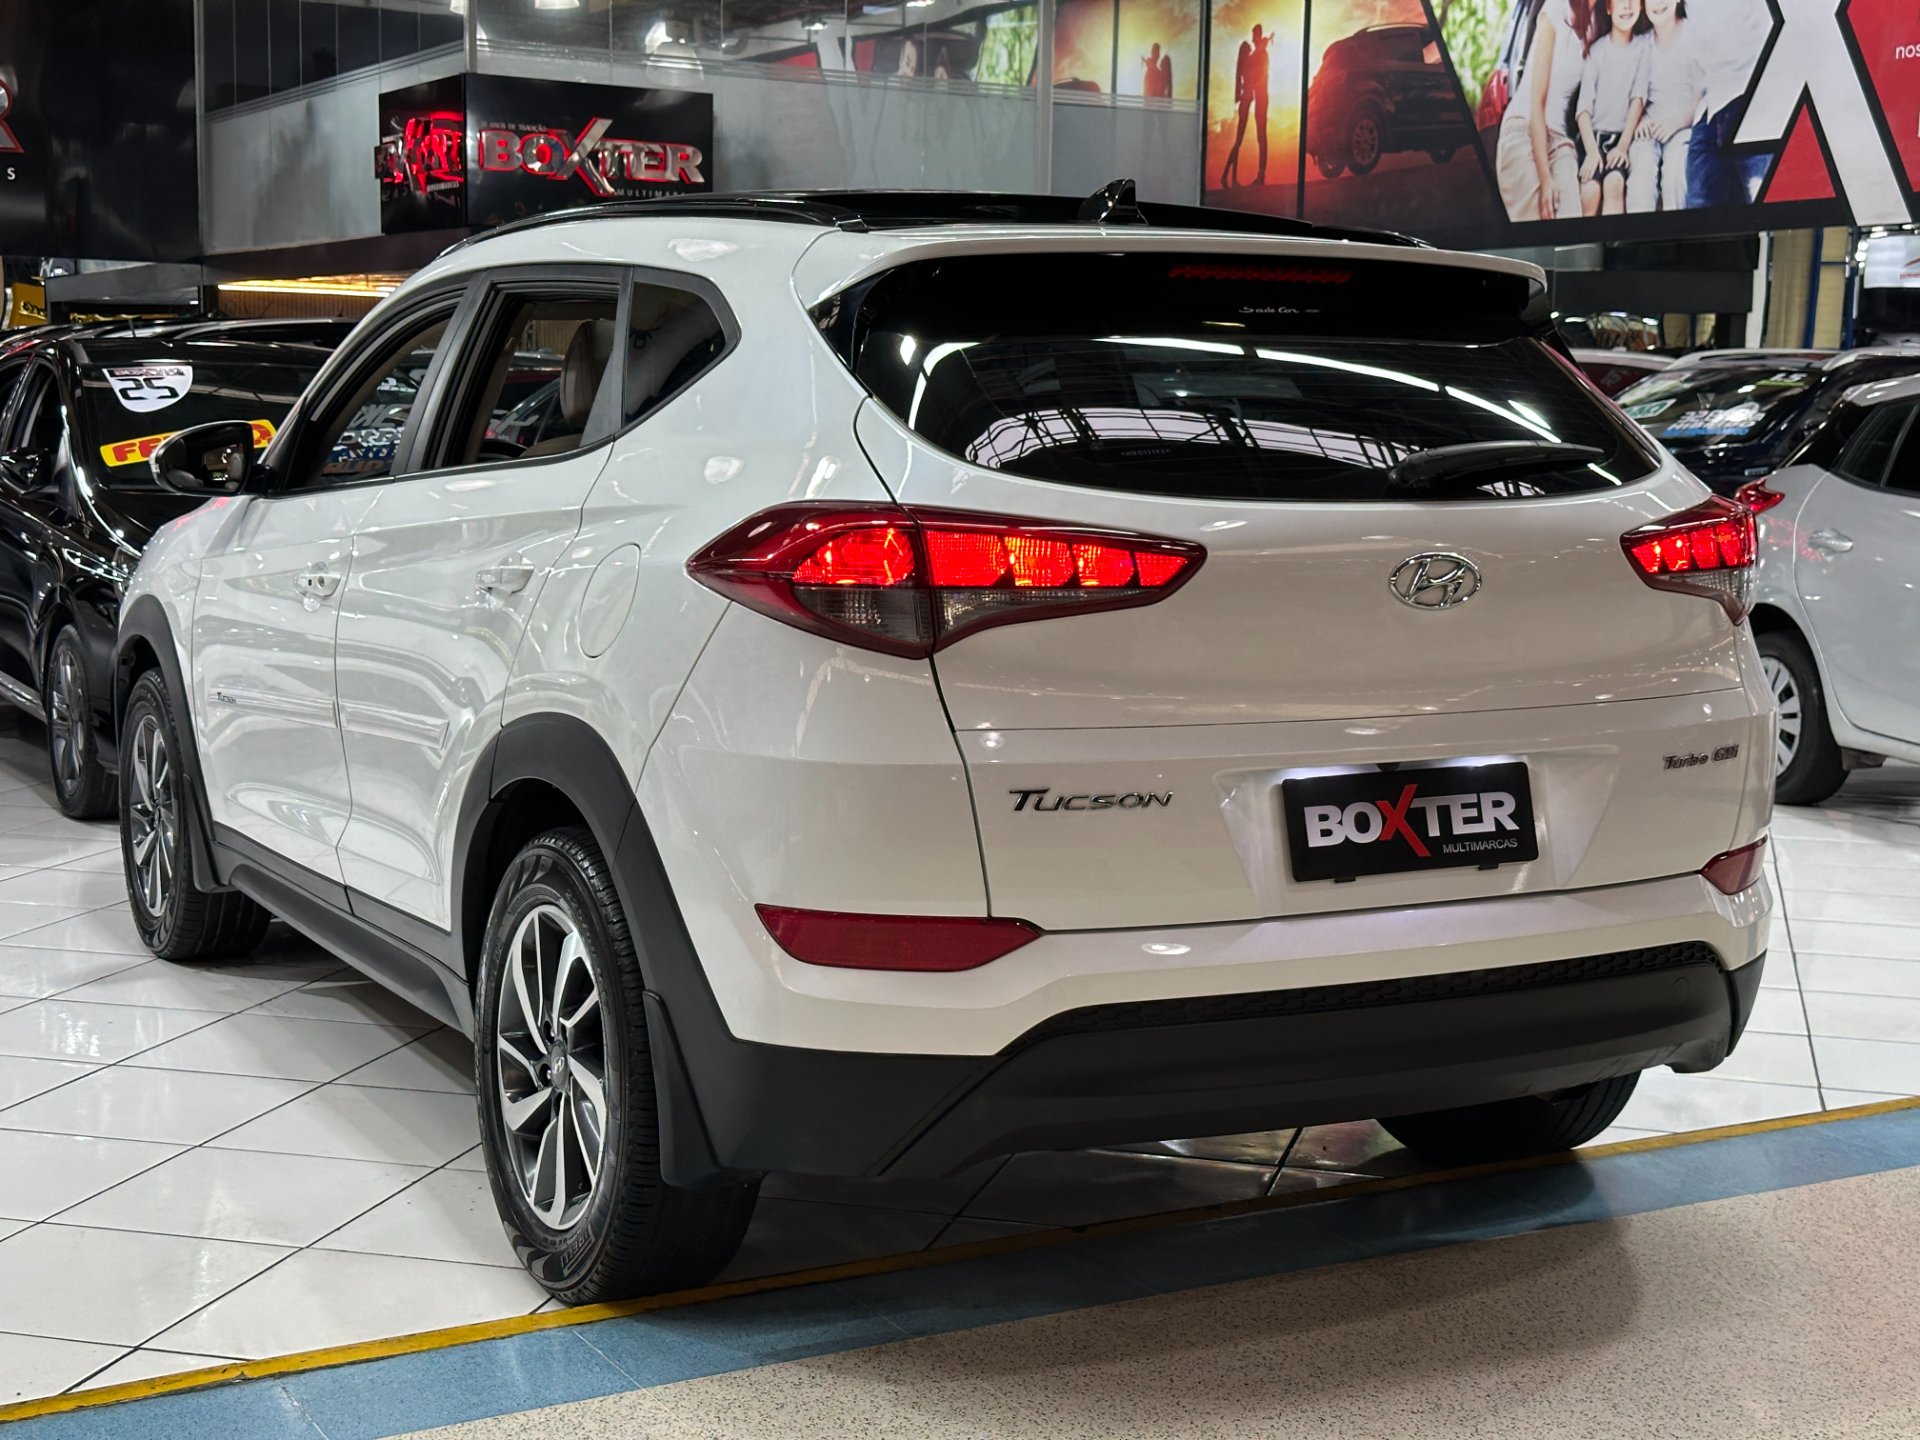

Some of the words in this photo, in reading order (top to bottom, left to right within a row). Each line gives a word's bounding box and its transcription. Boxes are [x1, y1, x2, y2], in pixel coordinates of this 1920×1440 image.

[478, 117, 704, 196] BOXTER
[1663, 752, 1708, 770] Turbo
[1304, 784, 1520, 857] BOXTER
[1443, 838, 1518, 854] MULTIMARCAS
